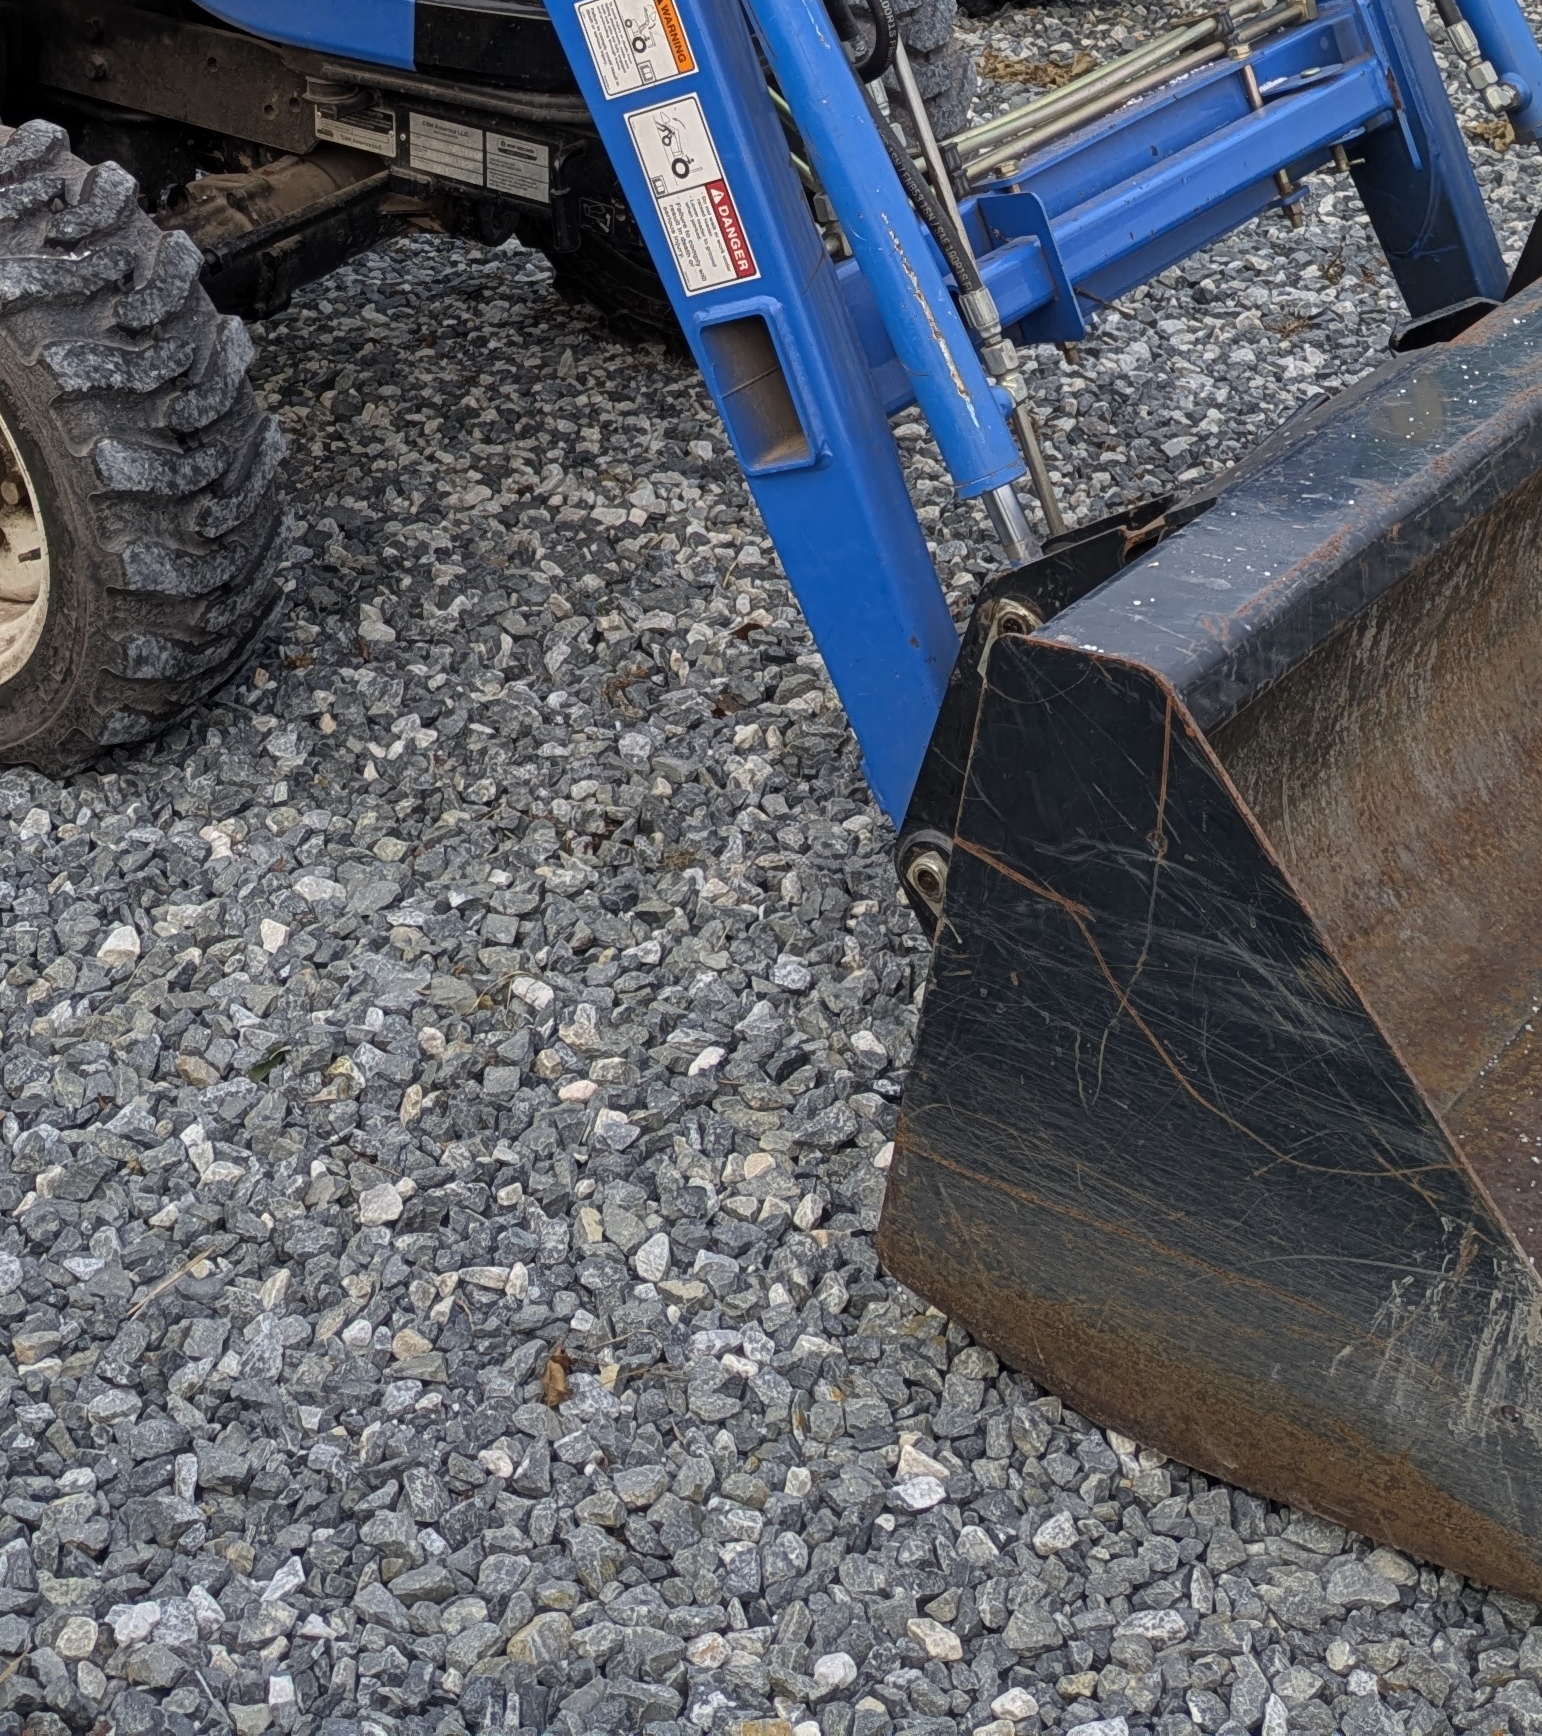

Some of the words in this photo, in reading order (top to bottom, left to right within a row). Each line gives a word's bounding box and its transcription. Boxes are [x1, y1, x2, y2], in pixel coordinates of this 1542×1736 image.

[659, 3, 687, 64] WARNING
[661, 205, 677, 234] serious
[668, 203, 681, 226] result
[679, 235, 692, 258] death
[673, 201, 689, 229] Failure
[686, 238, 702, 267] comply
[696, 267, 707, 282] will
[716, 204, 750, 271] DANGER
[935, 225, 950, 248] SAE
